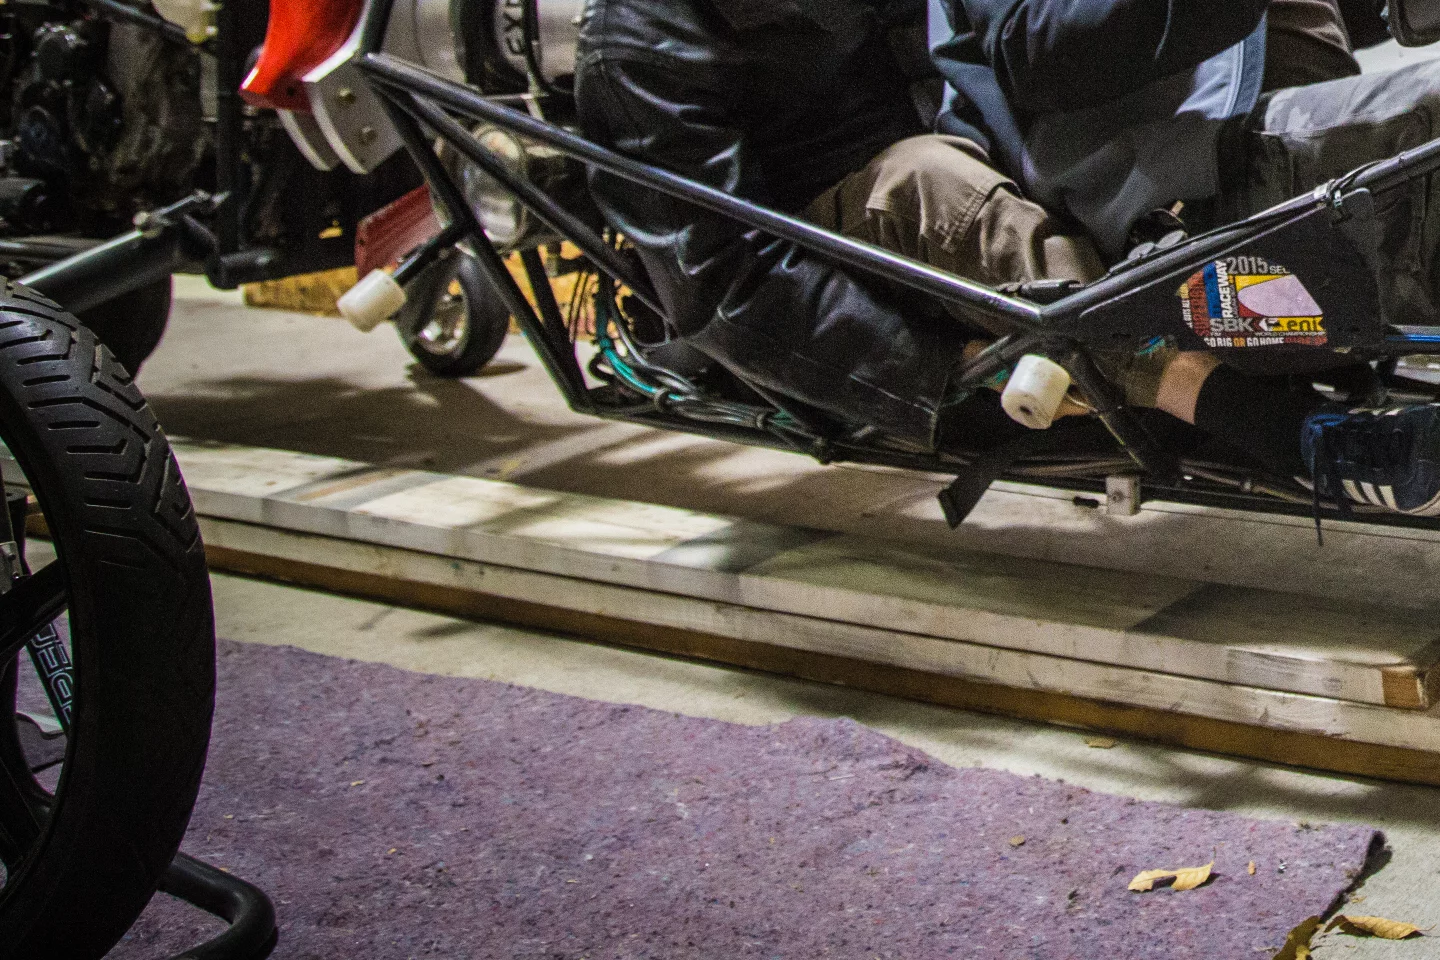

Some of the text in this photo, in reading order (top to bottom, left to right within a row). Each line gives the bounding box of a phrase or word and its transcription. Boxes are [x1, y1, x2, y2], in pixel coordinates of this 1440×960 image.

[1227, 256, 1268, 275] 2015
[1215, 260, 1234, 318] RACEWAY
[1210, 318, 1254, 333] SBK
